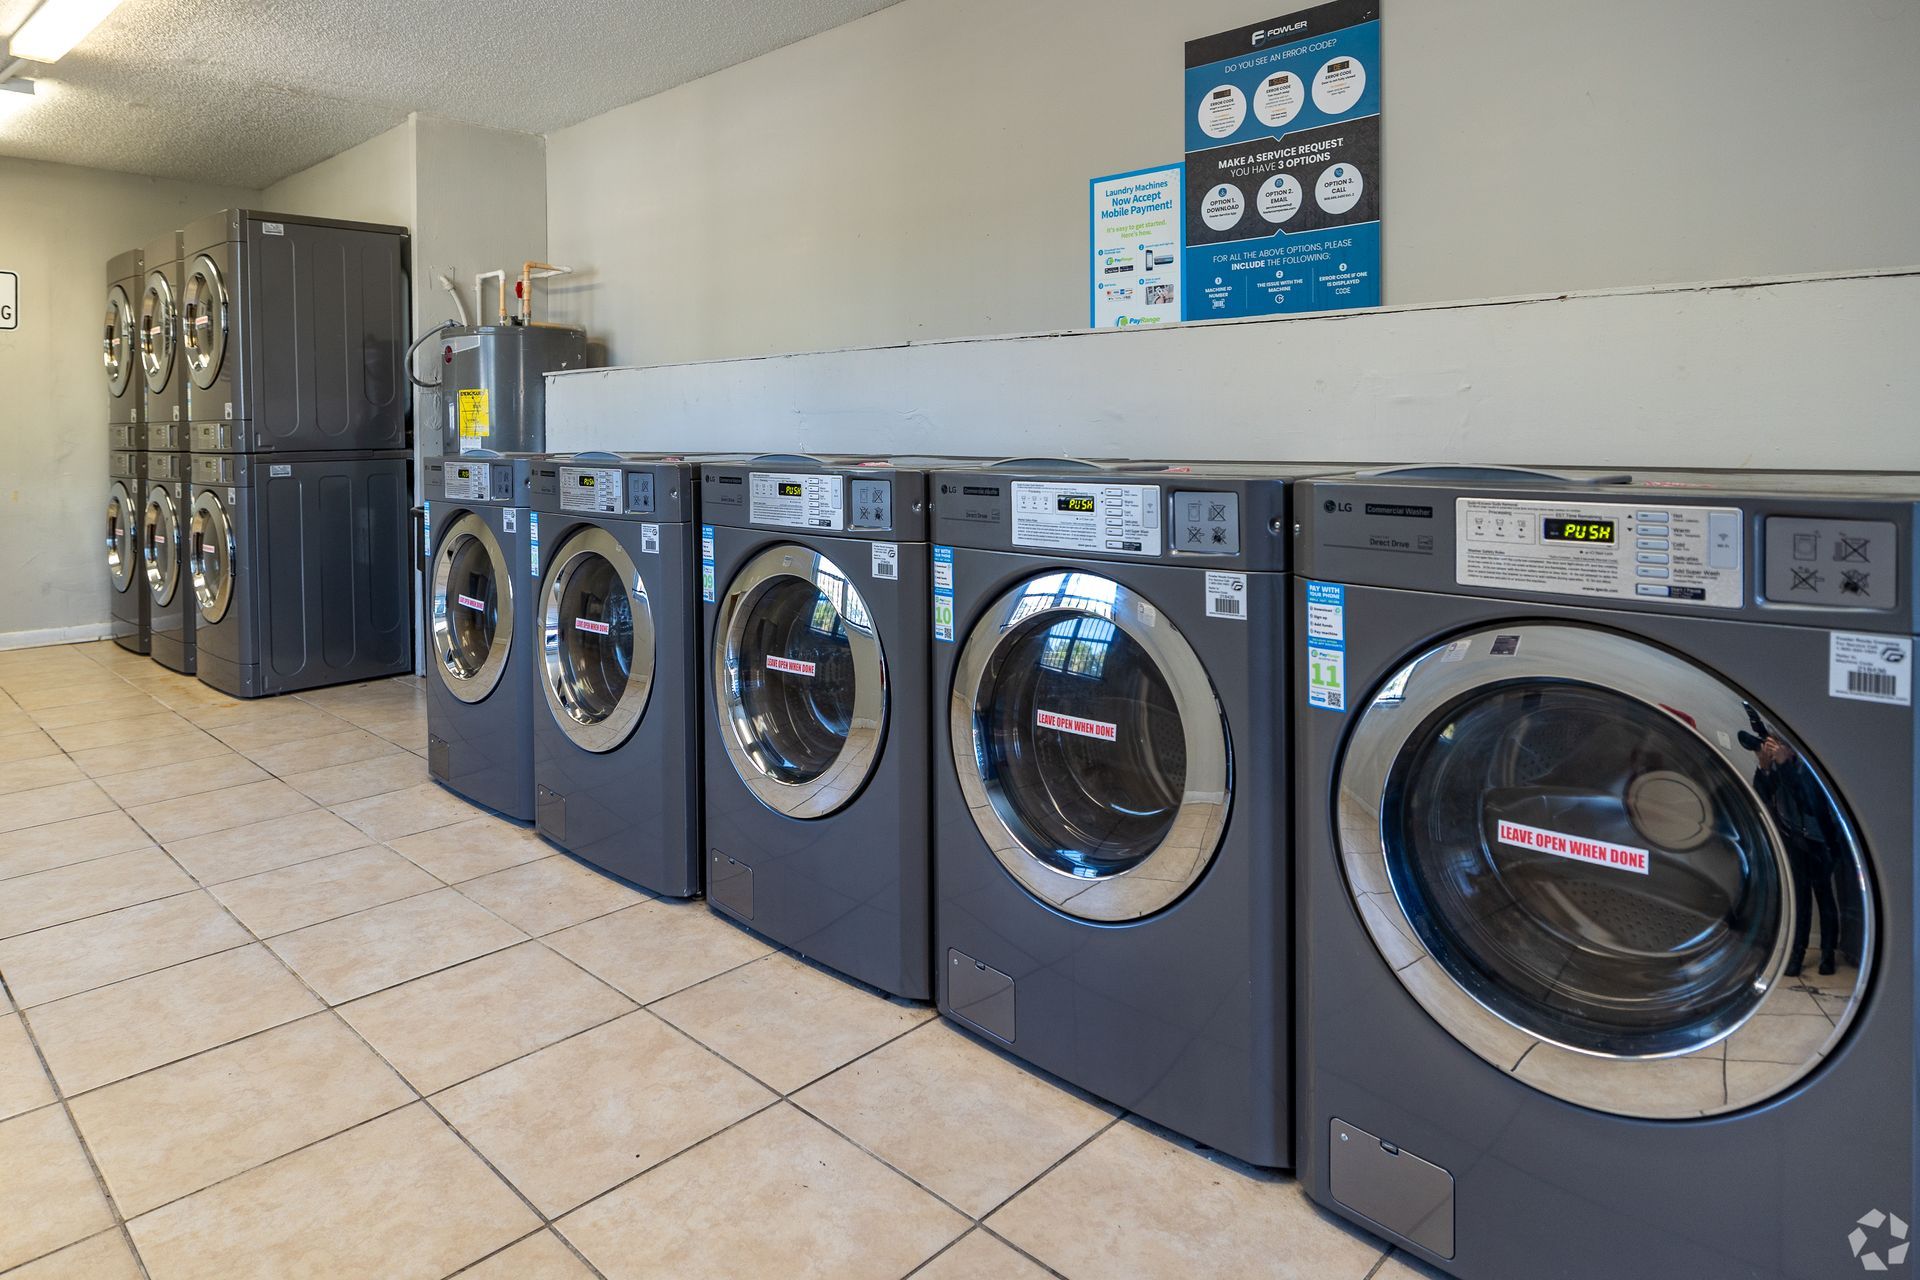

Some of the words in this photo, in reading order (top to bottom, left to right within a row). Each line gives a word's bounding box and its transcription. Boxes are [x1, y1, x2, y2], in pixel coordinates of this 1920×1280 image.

[1267, 20, 1308, 37] FOWLER
[1224, 64, 1237, 74] DO
[1238, 60, 1254, 71] YOU
[1255, 56, 1268, 66] SEE
[1270, 53, 1281, 62] AN
[1282, 46, 1308, 59] ERROR
[1308, 38, 1337, 52] CODE?
[1218, 156, 1246, 169] MAKE
[1247, 155, 1255, 164] A
[1256, 146, 1297, 162] SERVICE
[1230, 167, 1250, 178] YOU
[1252, 162, 1276, 174] HAVE
[1278, 160, 1284, 169] 3
[1286, 152, 1330, 168] OPTIONS
[1105, 186, 1134, 197] Laundry
[1135, 180, 1168, 192] Machines
[1324, 179, 1348, 188] OPTION
[1112, 197, 1131, 207] Now
[1132, 191, 1162, 203] Accept
[1265, 190, 1288, 198] OPTION
[1101, 208, 1129, 219] Mobile
[1130, 200, 1172, 215] Payment!
[1206, 204, 1240, 214] DOWNLOAD
[1213, 255, 1228, 263] FOR
[1243, 251, 1256, 260] THE
[1259, 248, 1284, 258] ABOVE
[1286, 244, 1323, 254] OPTIONS,
[1324, 239, 1352, 250] PLEASE
[1232, 260, 1266, 270] INCLUDE
[1267, 258, 1281, 267] THE
[1283, 252, 1331, 264] FOLLOWING:
[1069, 499, 1093, 510] PUSH
[1338, 503, 1352, 512] LG
[1367, 506, 1404, 515] Commercial
[1564, 524, 1611, 539] PUSH
[1392, 540, 1410, 548] Drive
[936, 607, 951, 625] 10
[779, 660, 788, 669] OPEN
[1312, 663, 1340, 688] 11
[1039, 713, 1056, 724] LEAVE
[1056, 718, 1072, 730] OPEN
[1074, 721, 1094, 734] WHEN
[1096, 725, 1114, 737] DONE
[1501, 825, 1533, 845] LEAVE
[1536, 833, 1566, 852] OPEN
[1569, 840, 1606, 861] WHEN
[1610, 849, 1645, 869] DONE
